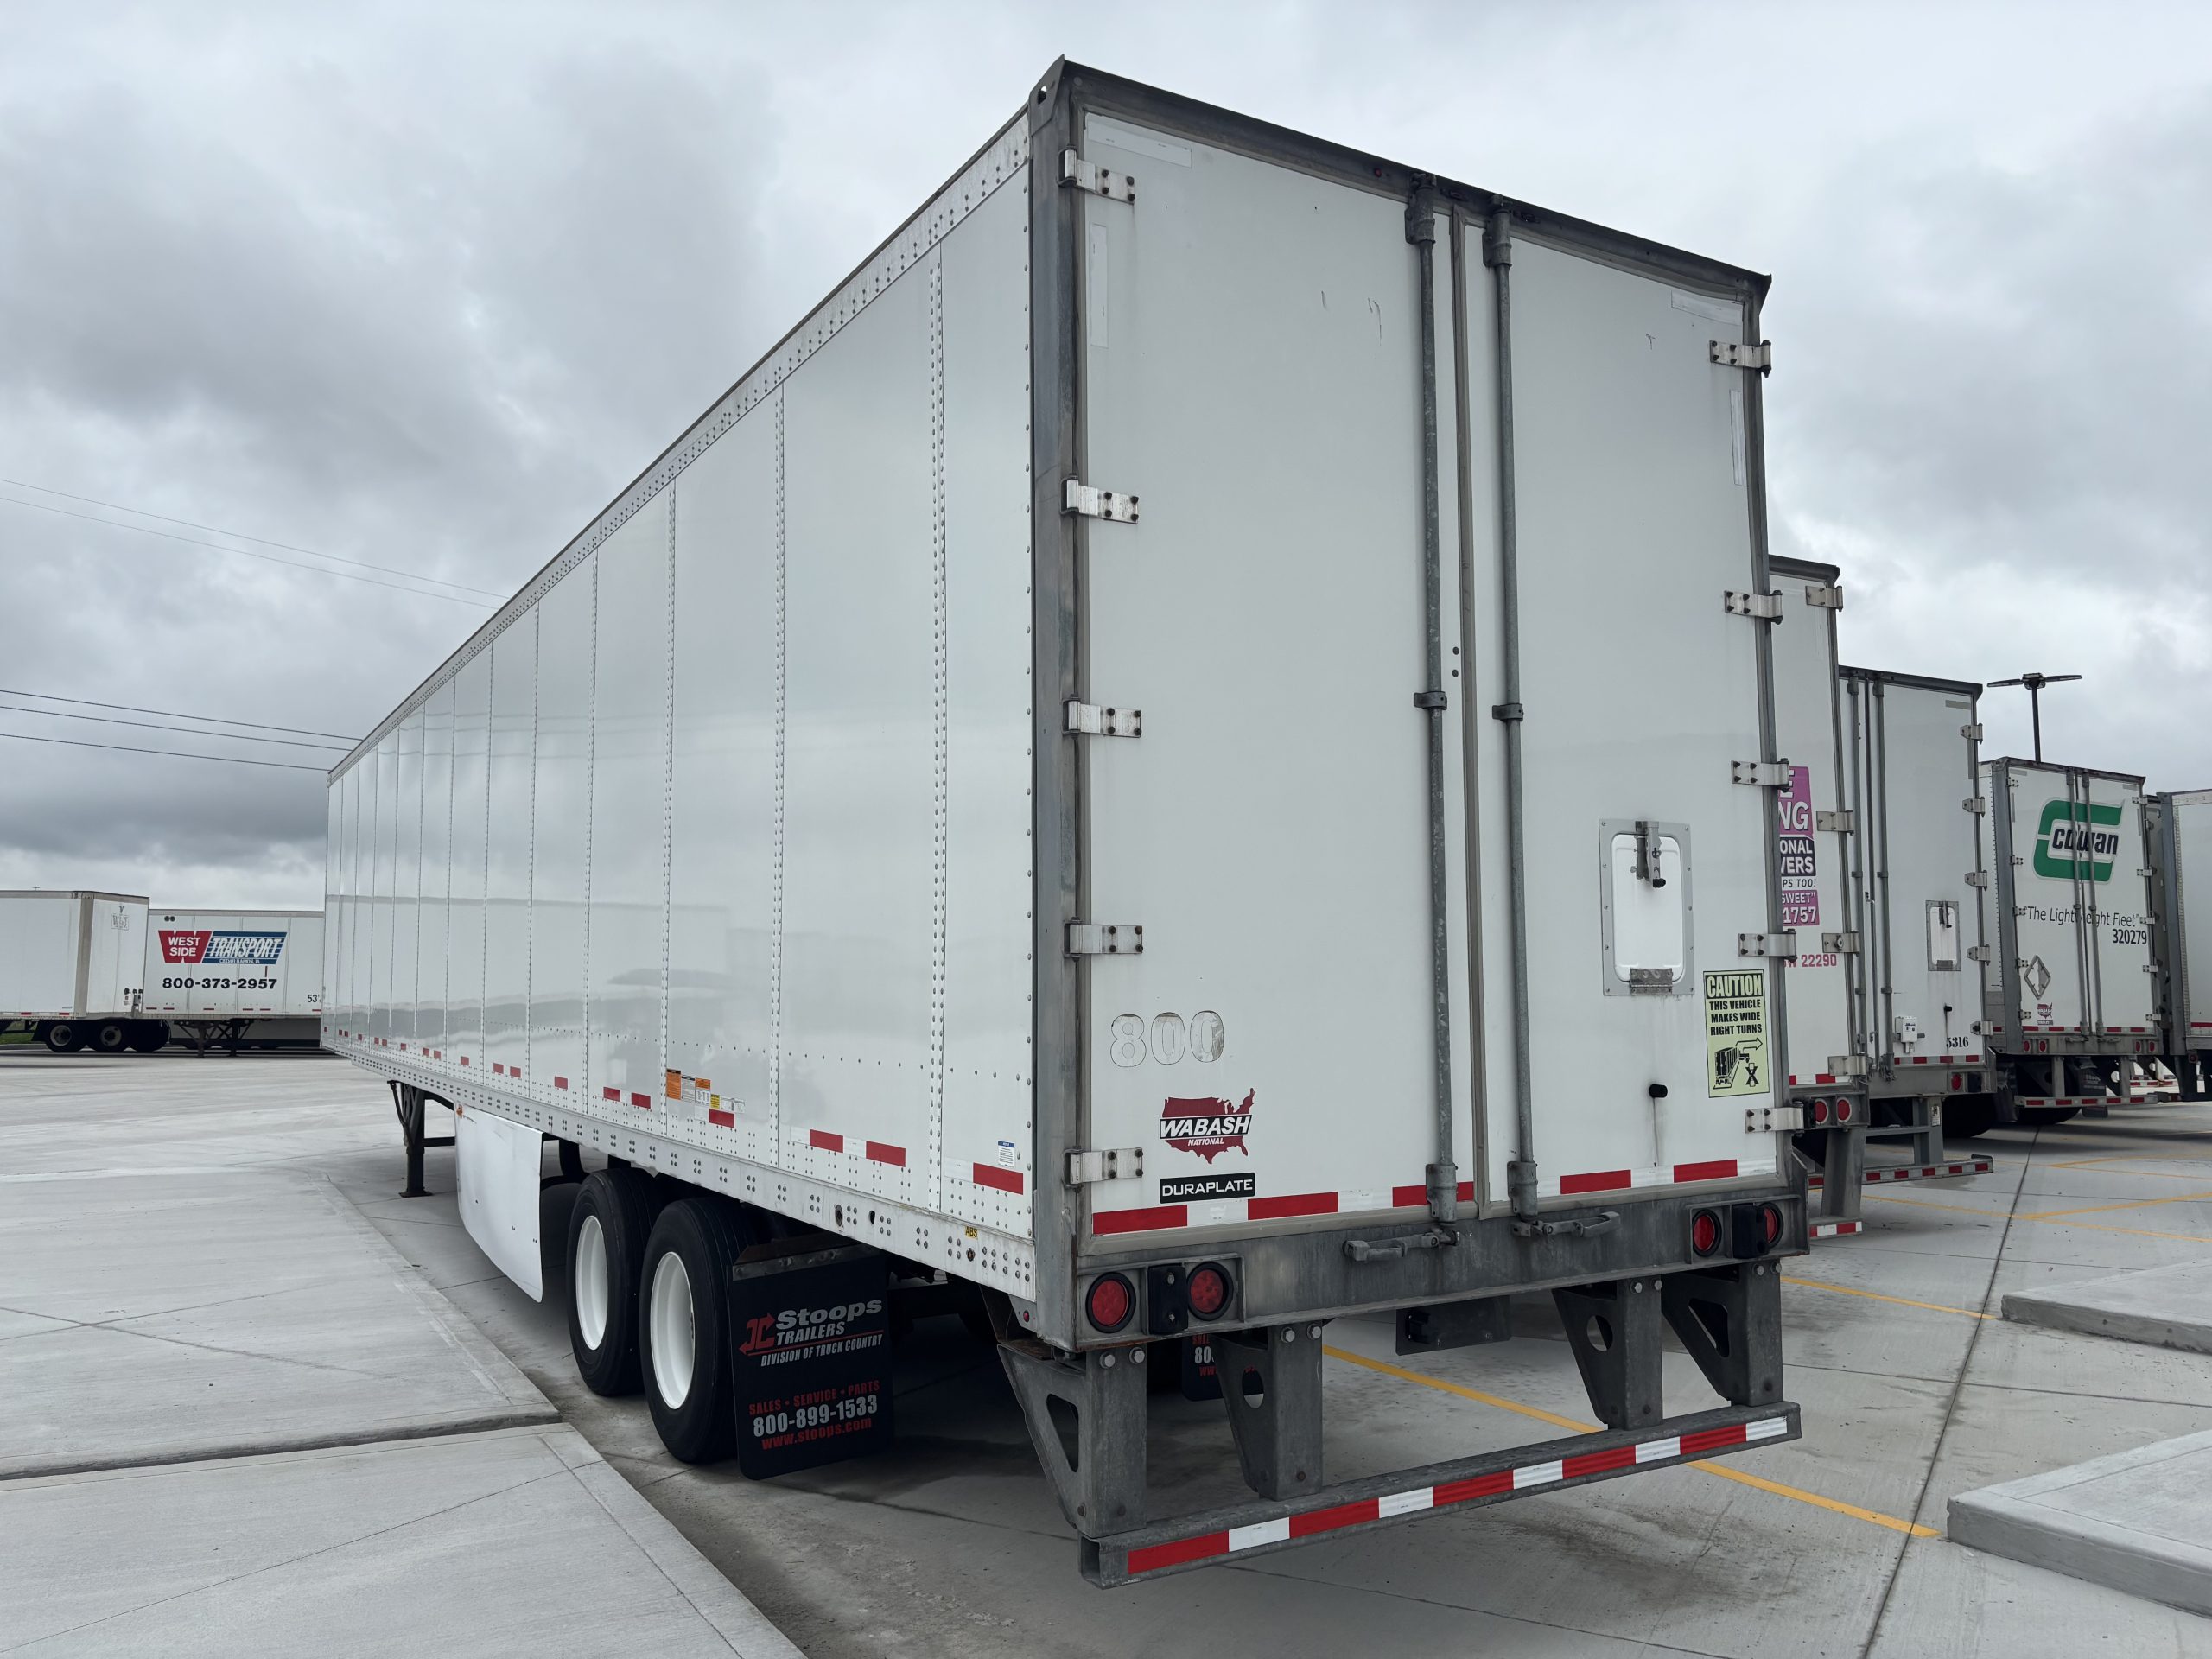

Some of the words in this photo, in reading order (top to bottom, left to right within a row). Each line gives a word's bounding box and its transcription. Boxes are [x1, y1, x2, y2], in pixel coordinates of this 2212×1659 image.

[1780, 839, 1813, 855] ONAL
[1796, 879, 1816, 887] TOO!
[168, 937, 200, 946] WEST
[2112, 929, 2147, 945] 320279
[169, 947, 196, 957] SIDE
[209, 937, 282, 957] TRANSPORT
[1801, 954, 1837, 967] 22290
[162, 977, 277, 989] 800-373-2957
[1707, 975, 1763, 998] CAUTION
[1709, 1001, 1728, 1011] THIS
[1730, 999, 1761, 1009] VEHICLE
[1711, 1013, 1738, 1023] MAKES
[1739, 1012, 1761, 1021] WIDE
[1710, 1025, 1735, 1036] RIGHT
[1736, 1024, 1763, 1034] TURNS
[1110, 1010, 1224, 1068] 800
[1946, 1036, 1969, 1048] 5316
[1160, 1115, 1251, 1138] WABASH
[1187, 1137, 1224, 1147] NATIONAL
[1162, 1179, 1253, 1197] DURAPLATE
[965, 1225, 978, 1238] ABS
[776, 1299, 882, 1330] Stoops
[777, 1321, 845, 1345] TRAILERS
[760, 1350, 801, 1367] DIVISION
[803, 1347, 814, 1359] OF
[816, 1342, 843, 1357] TRUCK
[845, 1334, 883, 1351] COUNTRY
[1194, 1346, 1215, 1364] 80
[748, 1398, 782, 1415] SALES
[793, 1389, 837, 1407] SERVICE
[848, 1380, 880, 1396] PARTS
[753, 1394, 878, 1438] 800-899-1533
[761, 1418, 872, 1451] www.stoops.com
